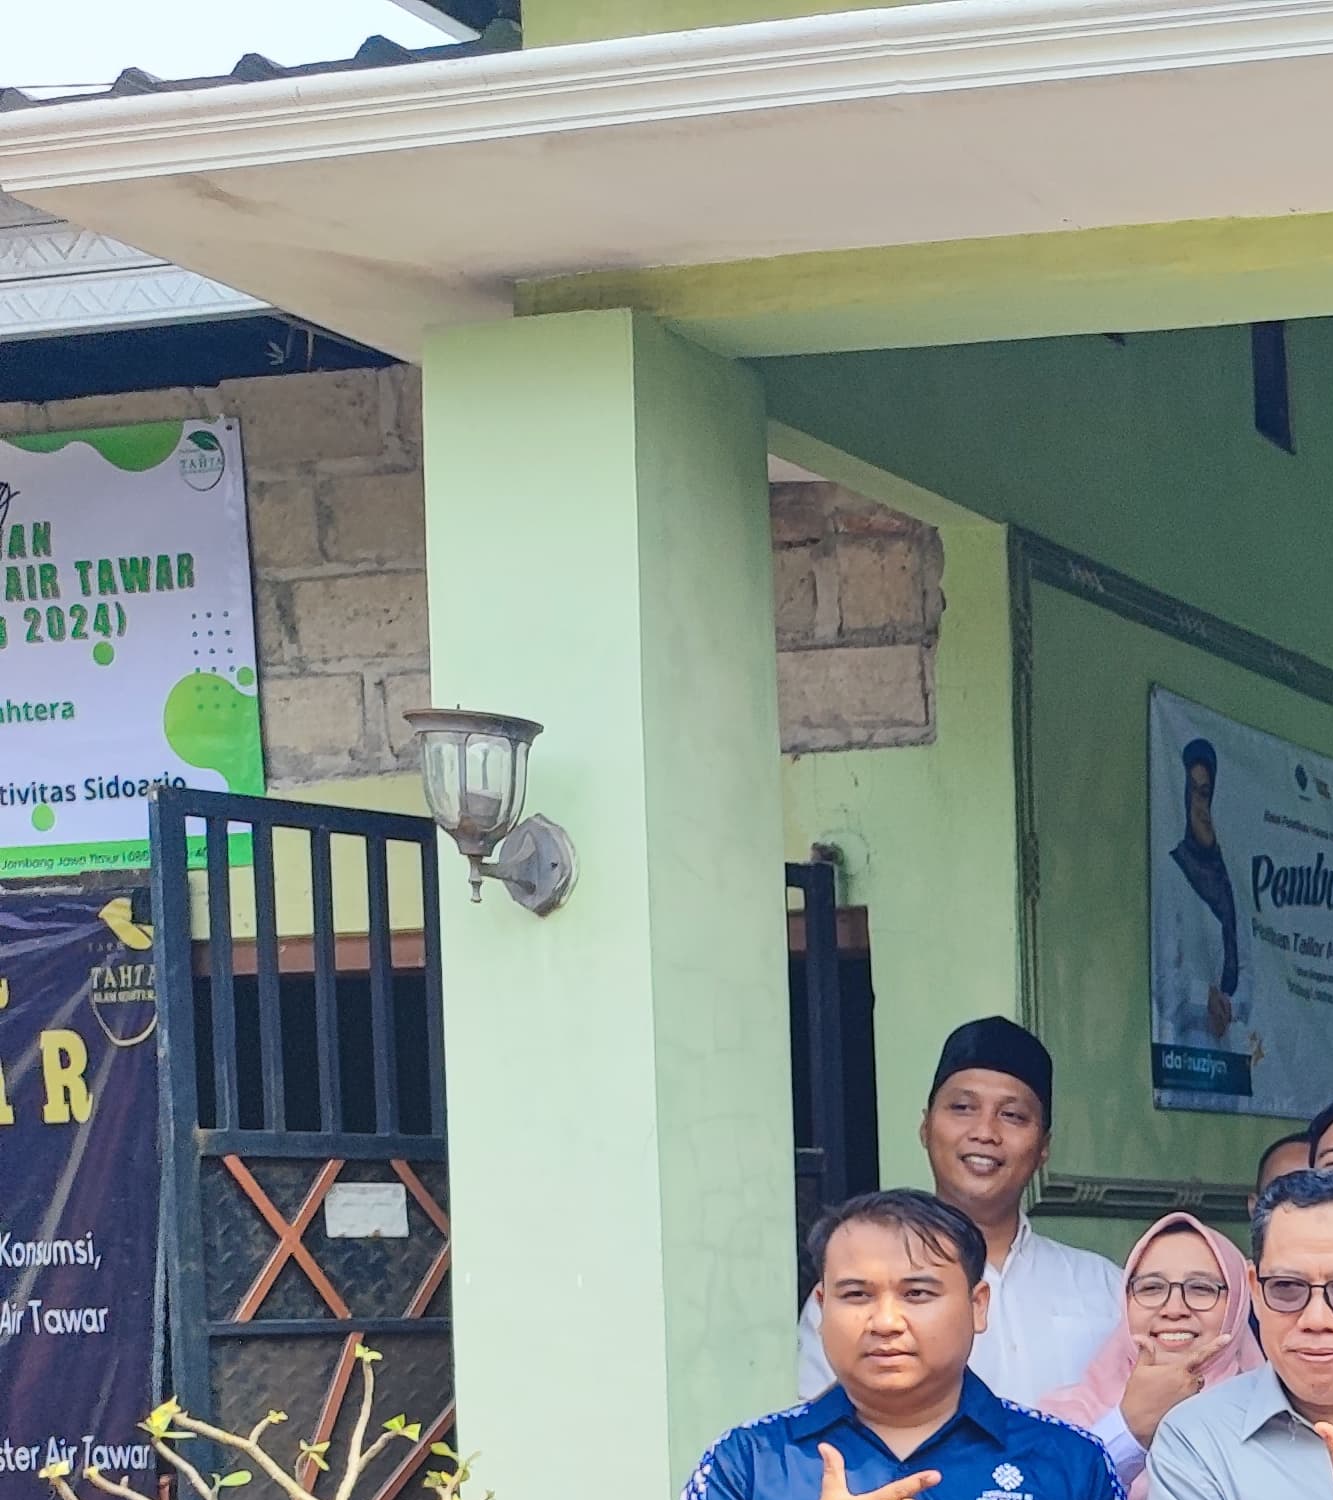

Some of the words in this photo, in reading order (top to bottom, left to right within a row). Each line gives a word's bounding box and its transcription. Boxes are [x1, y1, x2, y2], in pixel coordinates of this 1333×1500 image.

[5, 563, 60, 602] AIR
[74, 552, 195, 598] TAWAR
[23, 601, 127, 644] 2024)
[0, 1231, 102, 1271] Konsumsi,
[0, 1299, 25, 1336] Air
[28, 1299, 109, 1336] Tawar
[46, 1435, 77, 1471] Air
[81, 1434, 151, 1472] Tawar
